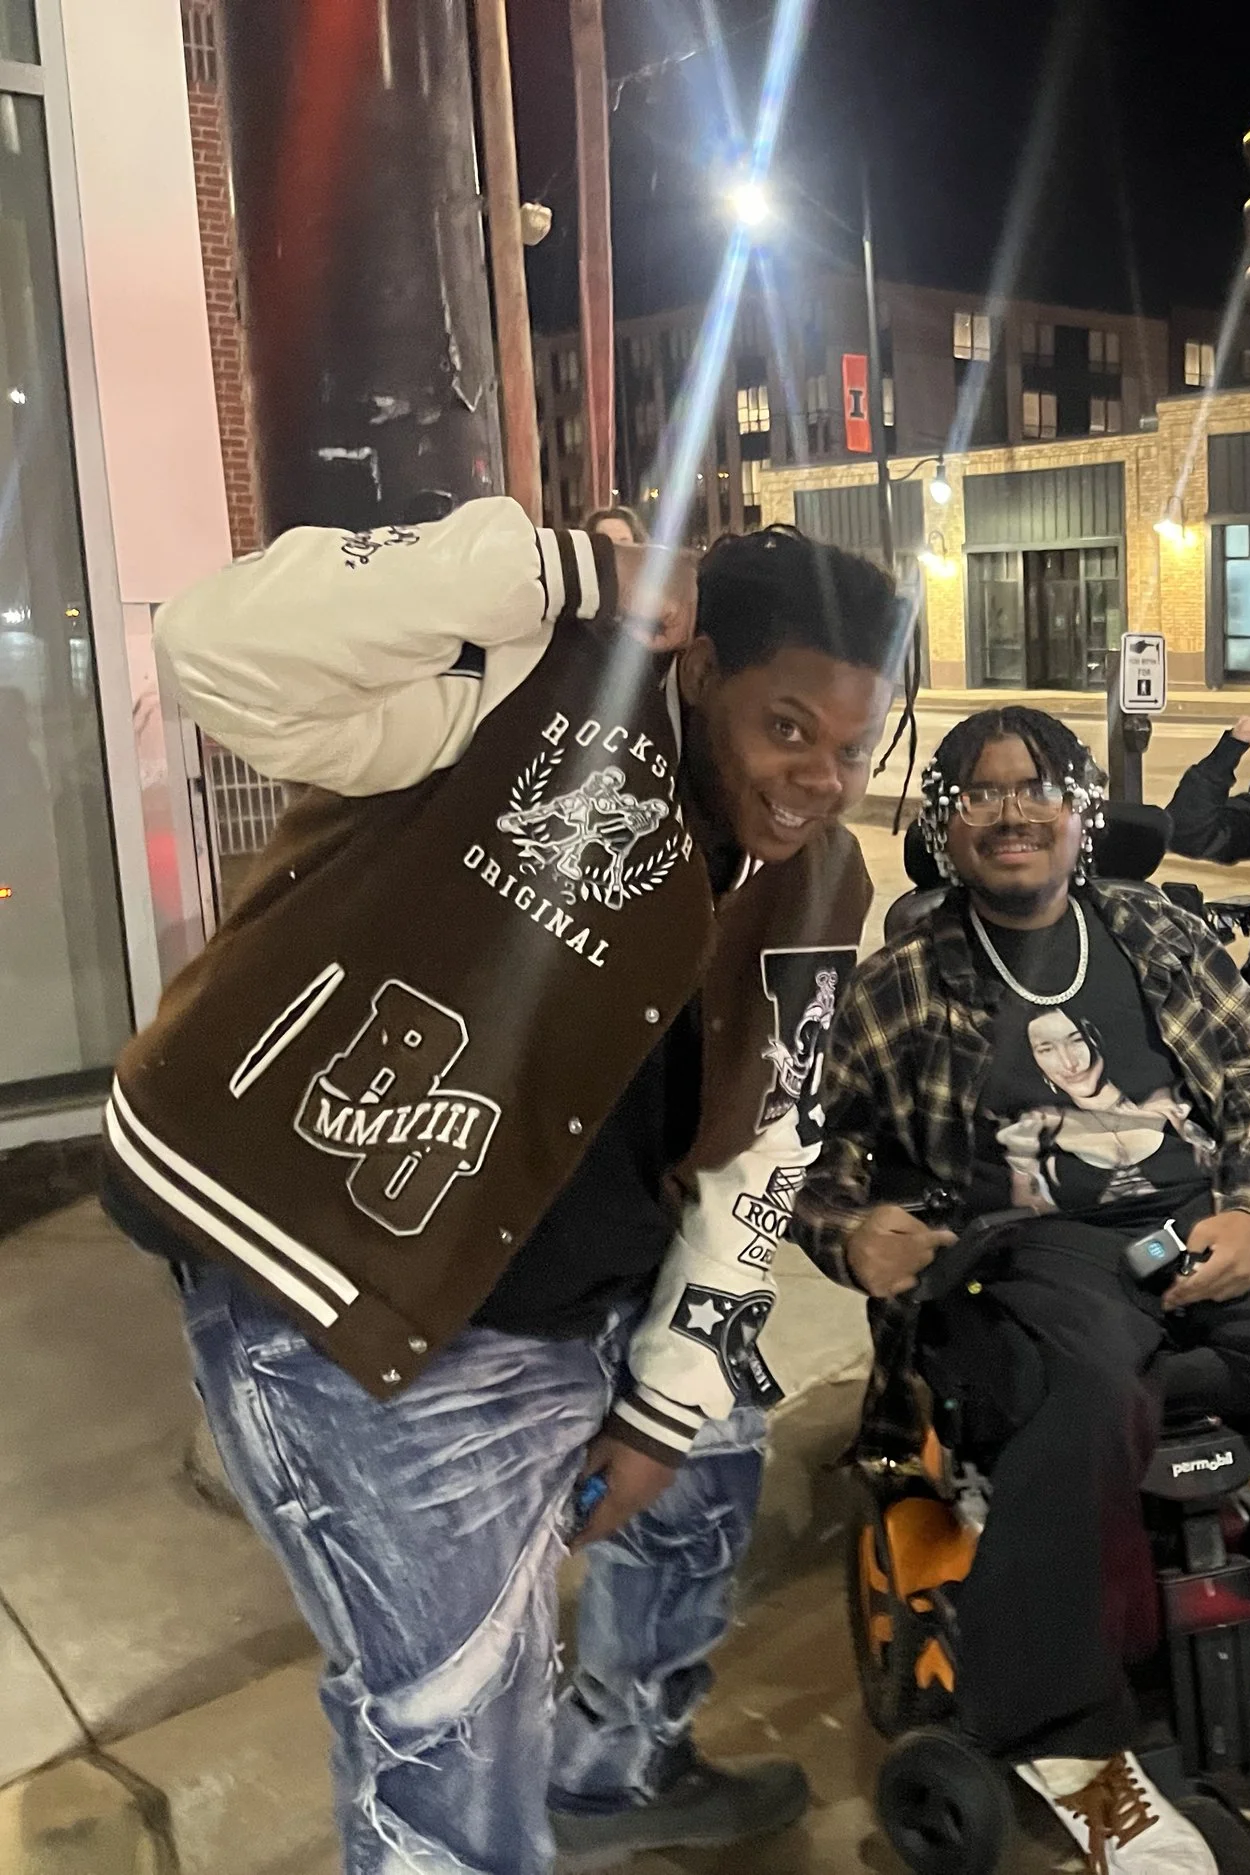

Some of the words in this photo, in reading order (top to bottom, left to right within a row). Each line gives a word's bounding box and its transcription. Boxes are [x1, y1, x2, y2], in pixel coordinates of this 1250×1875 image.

[463, 844, 610, 968] ORIGINAL
[315, 1098, 480, 1149] MMVIII
[1171, 1450, 1234, 1478] permobil
